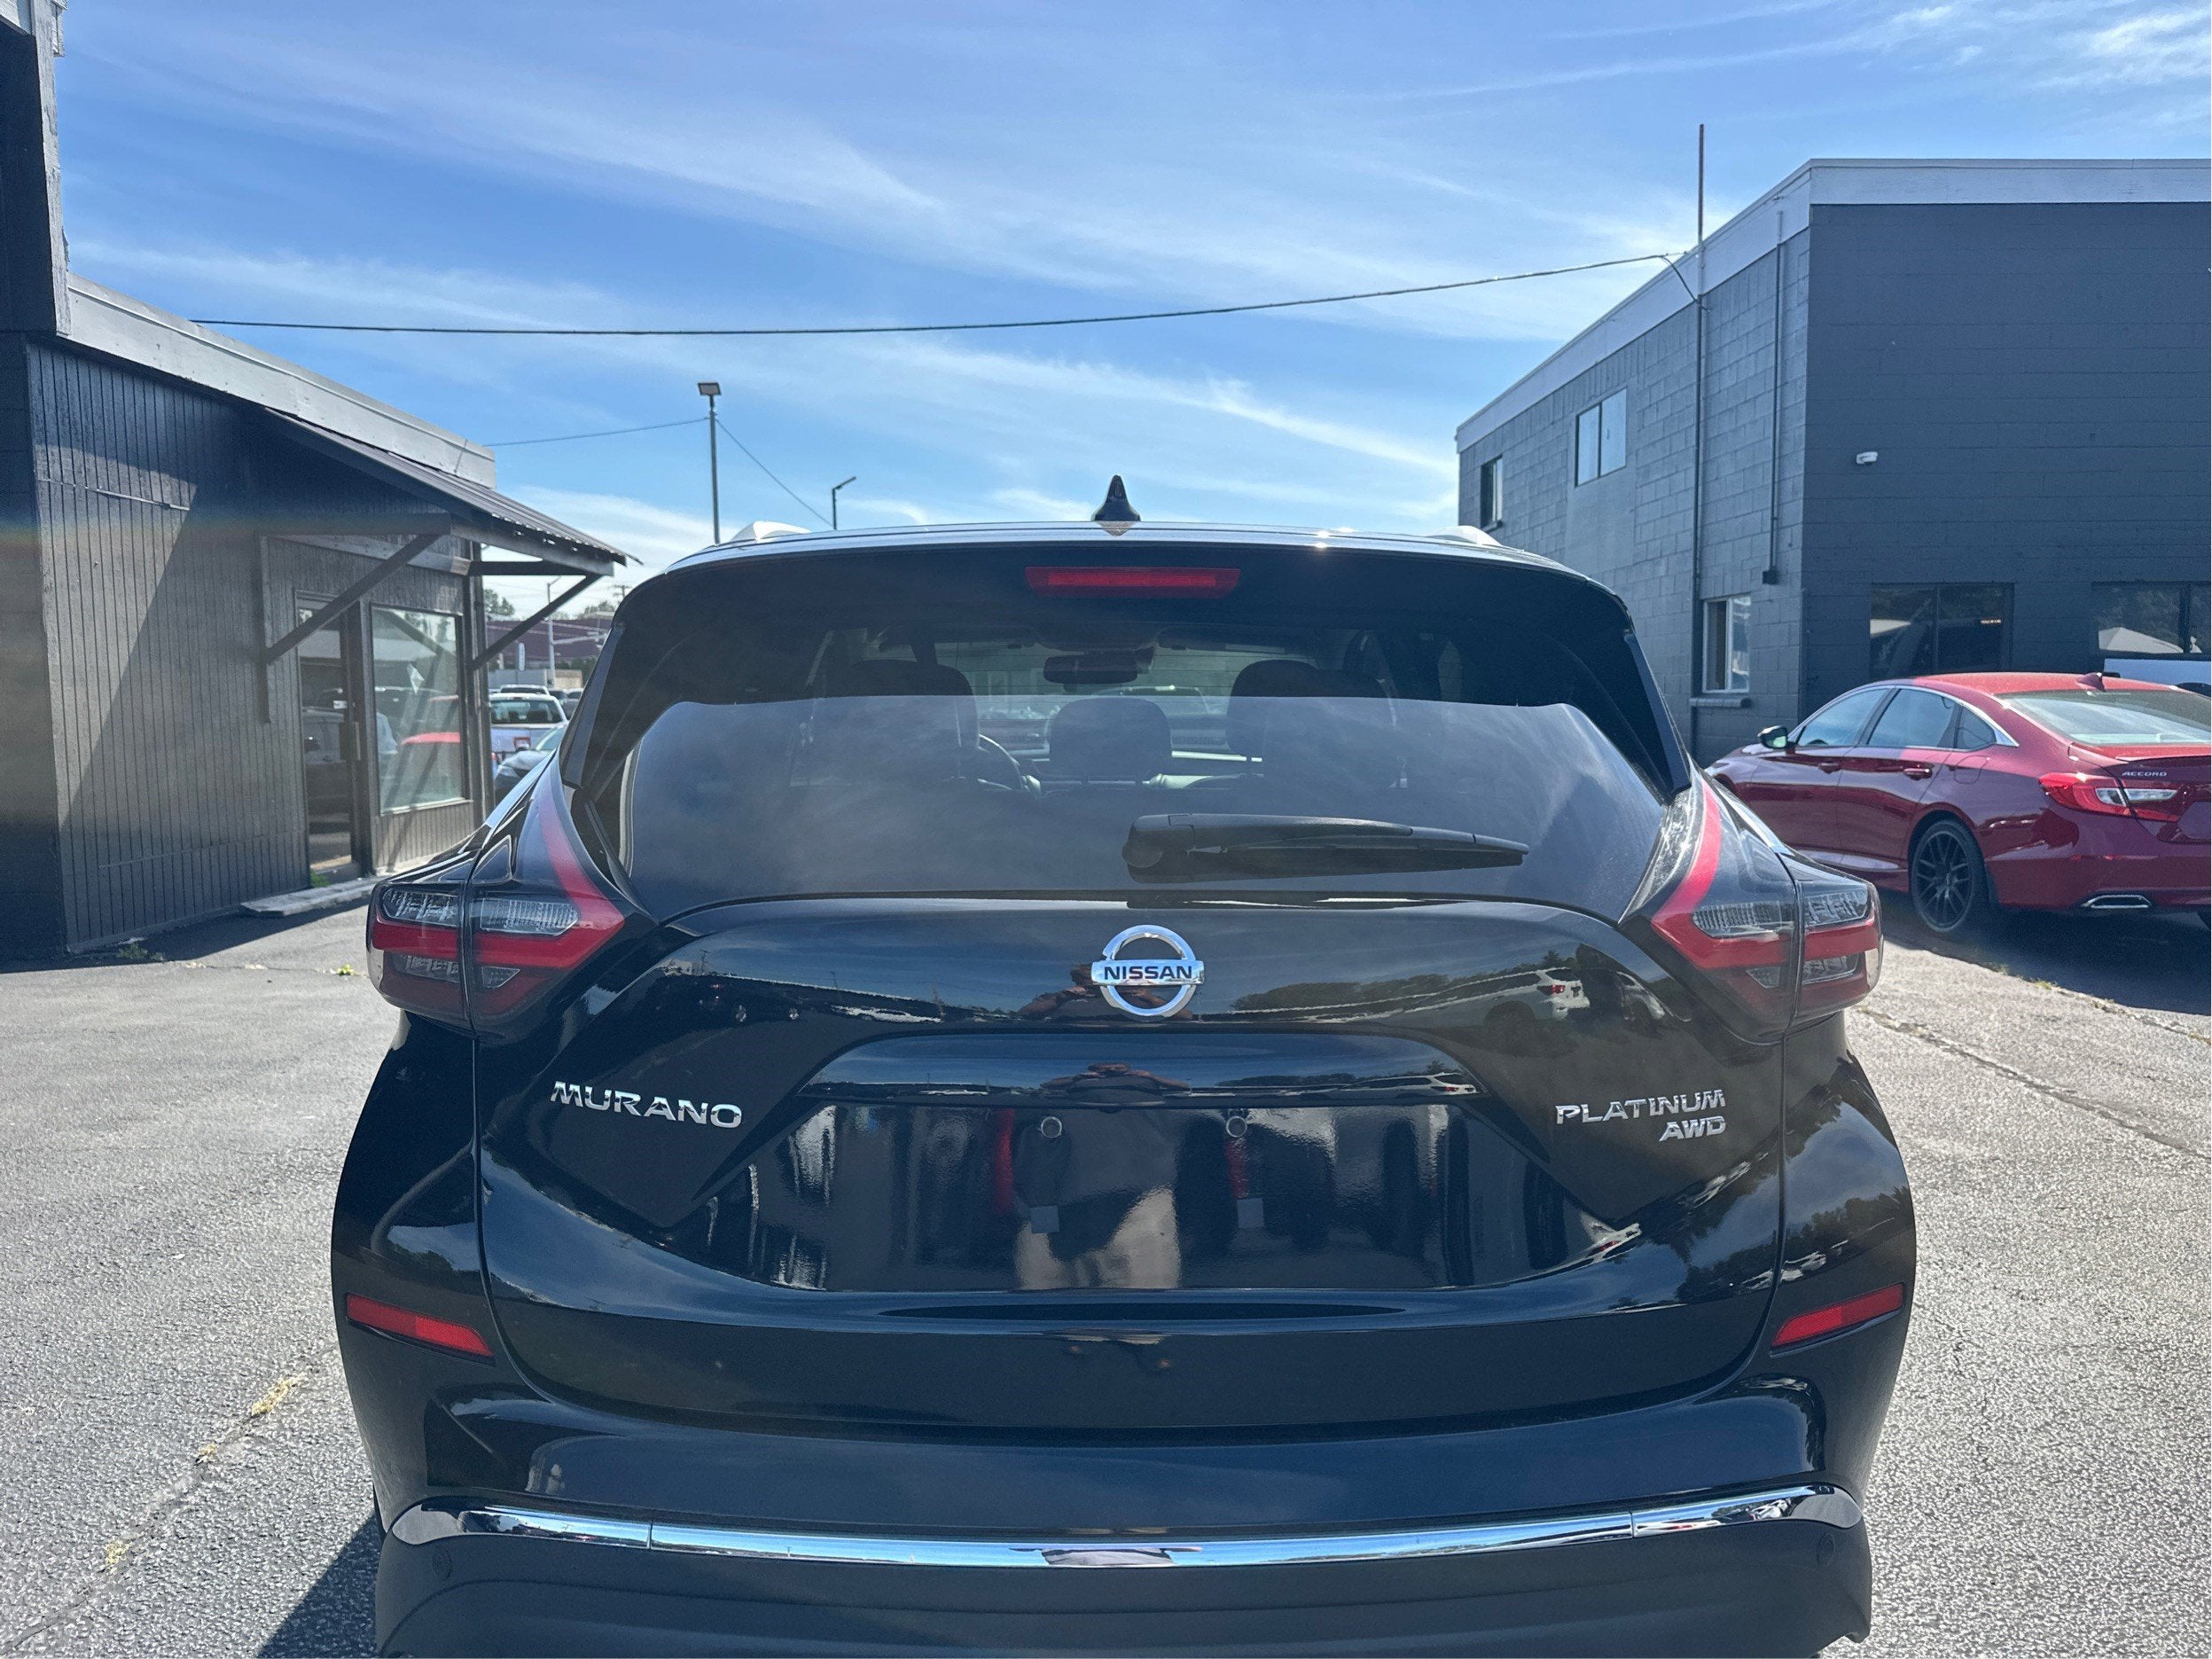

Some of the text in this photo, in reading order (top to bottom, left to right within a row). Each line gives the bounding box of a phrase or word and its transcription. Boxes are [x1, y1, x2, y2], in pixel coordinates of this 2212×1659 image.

[1104, 966, 1192, 980] NISSAN
[550, 1080, 742, 1129] MURANO
[1555, 1089, 1726, 1124] PLATINUM
[1659, 1115, 1726, 1142] AWD
